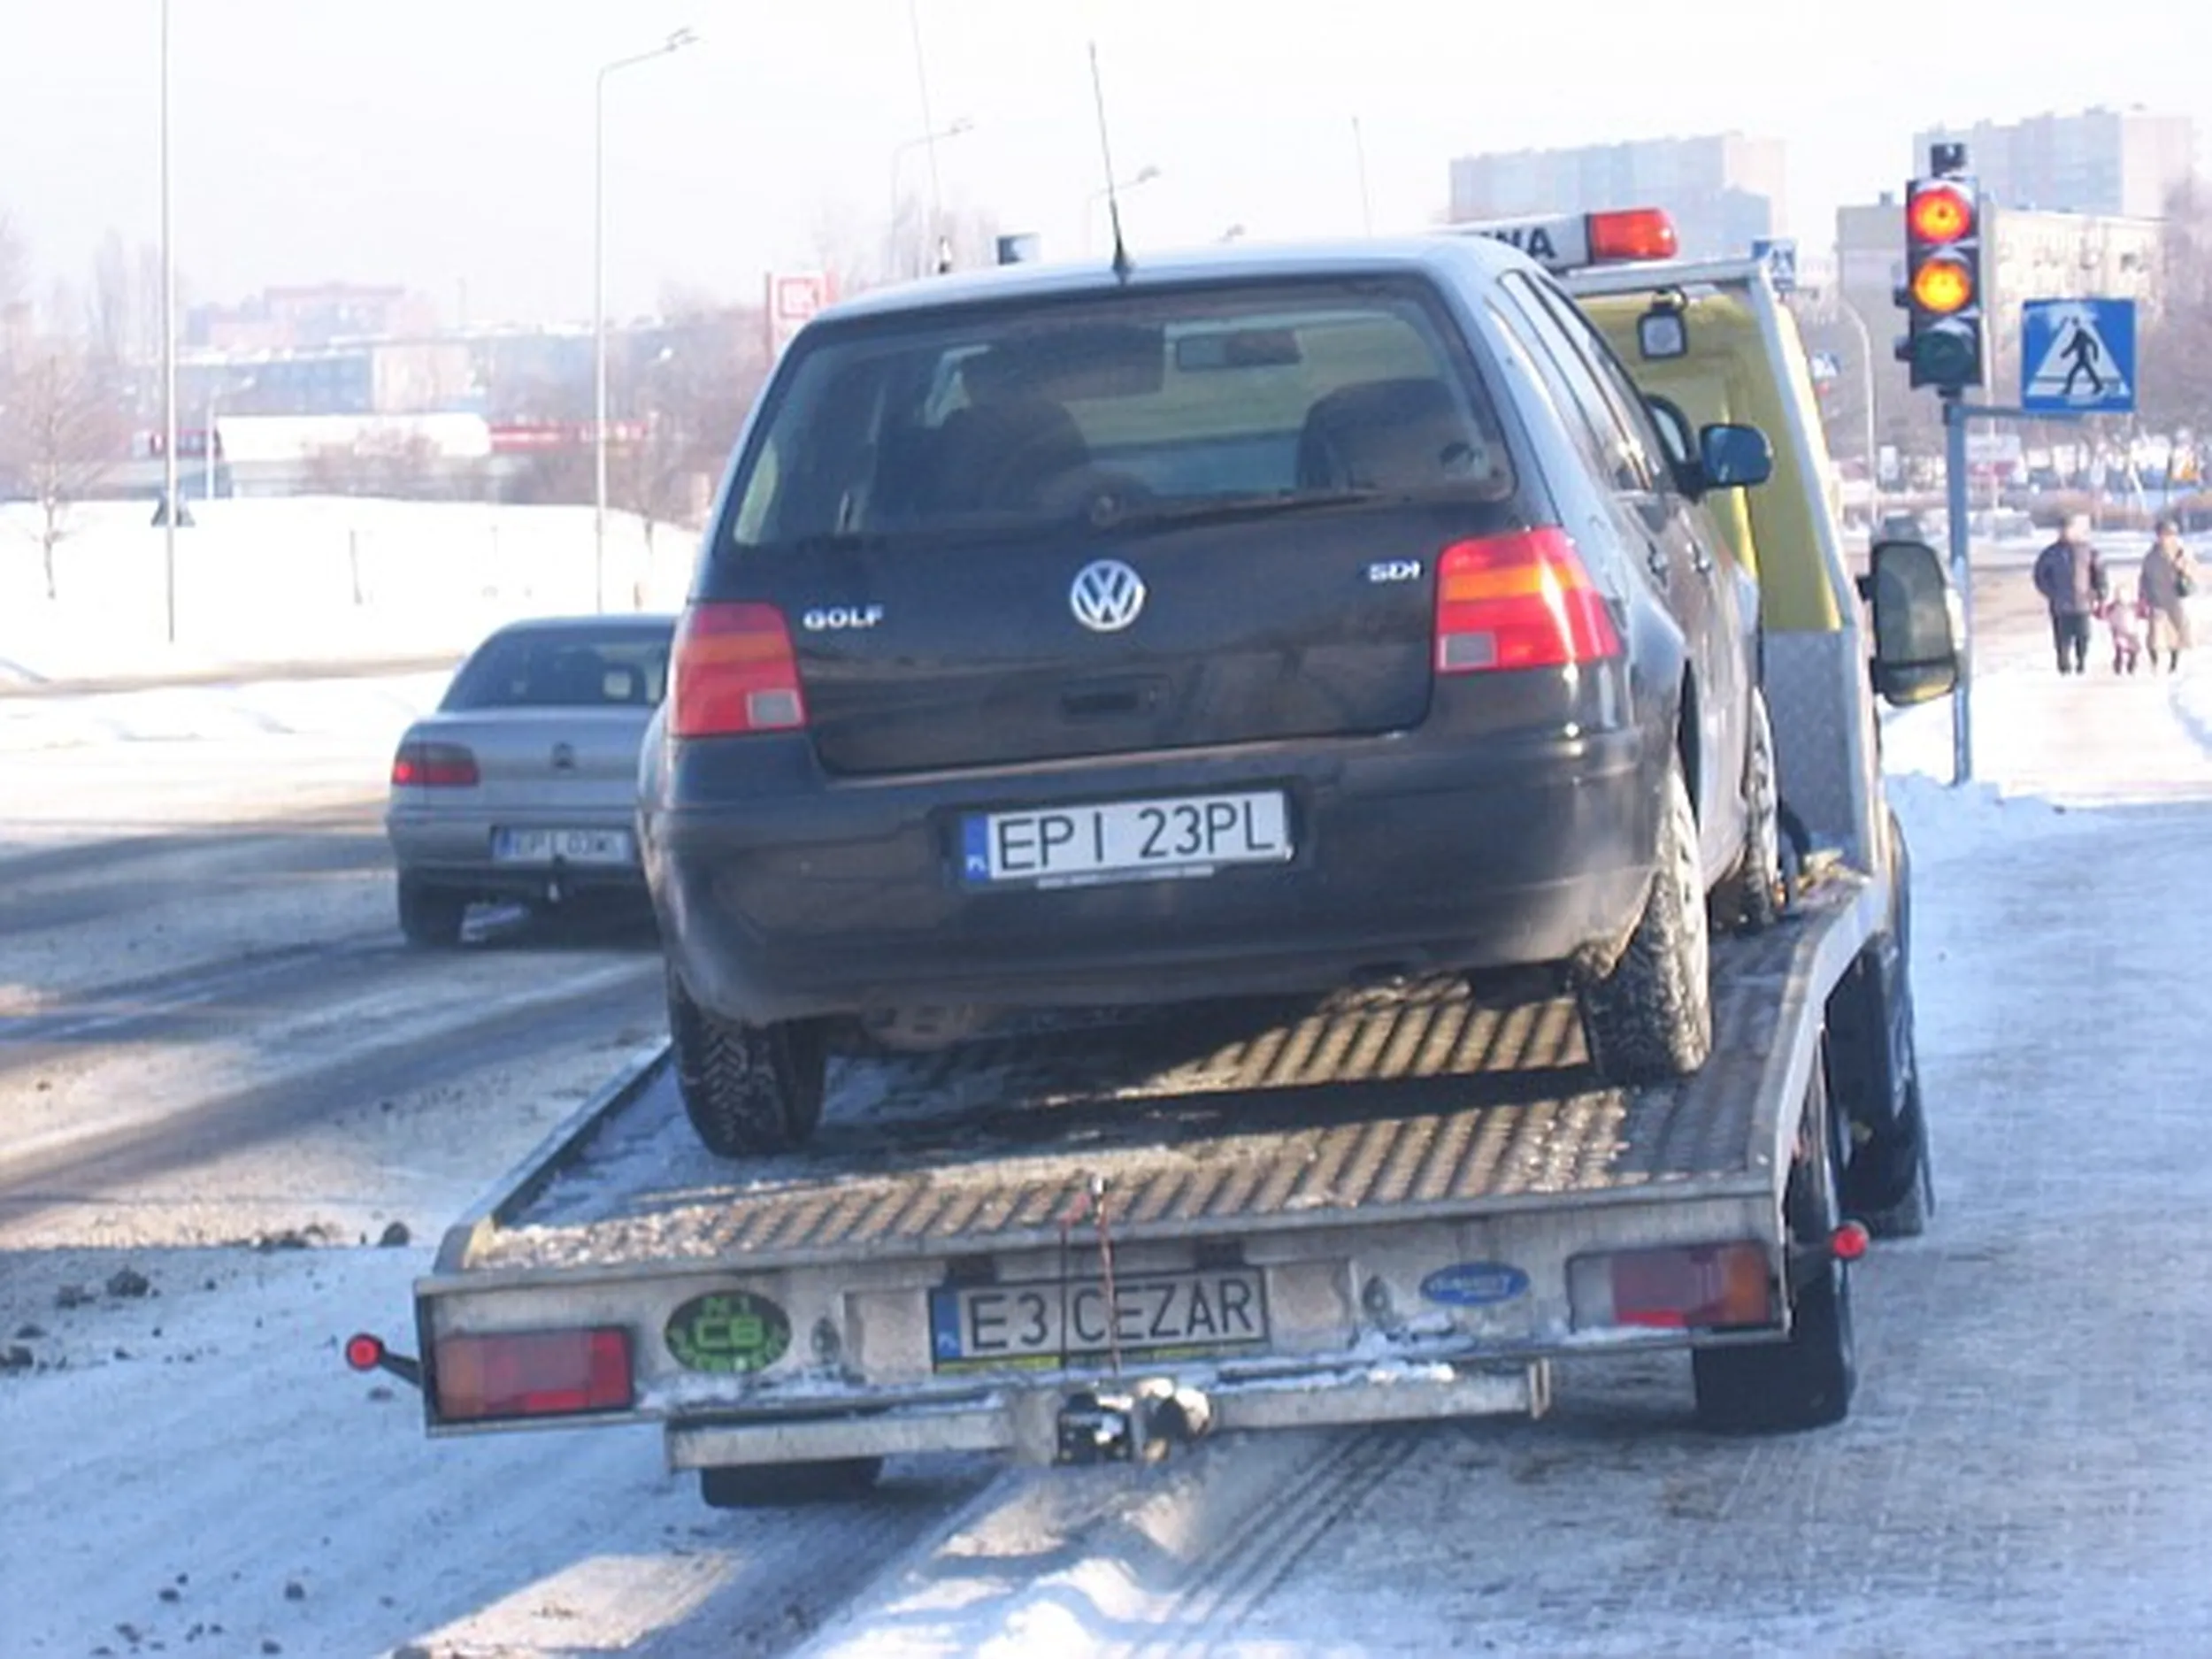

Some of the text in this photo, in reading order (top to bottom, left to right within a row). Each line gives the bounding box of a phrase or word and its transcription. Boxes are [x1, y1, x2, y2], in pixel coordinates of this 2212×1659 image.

[1369, 560, 1421, 582] SDI
[803, 604, 883, 631] GOLF
[996, 800, 1275, 871] EPI 23PL
[968, 1279, 1253, 1351] E3 CEZAR
